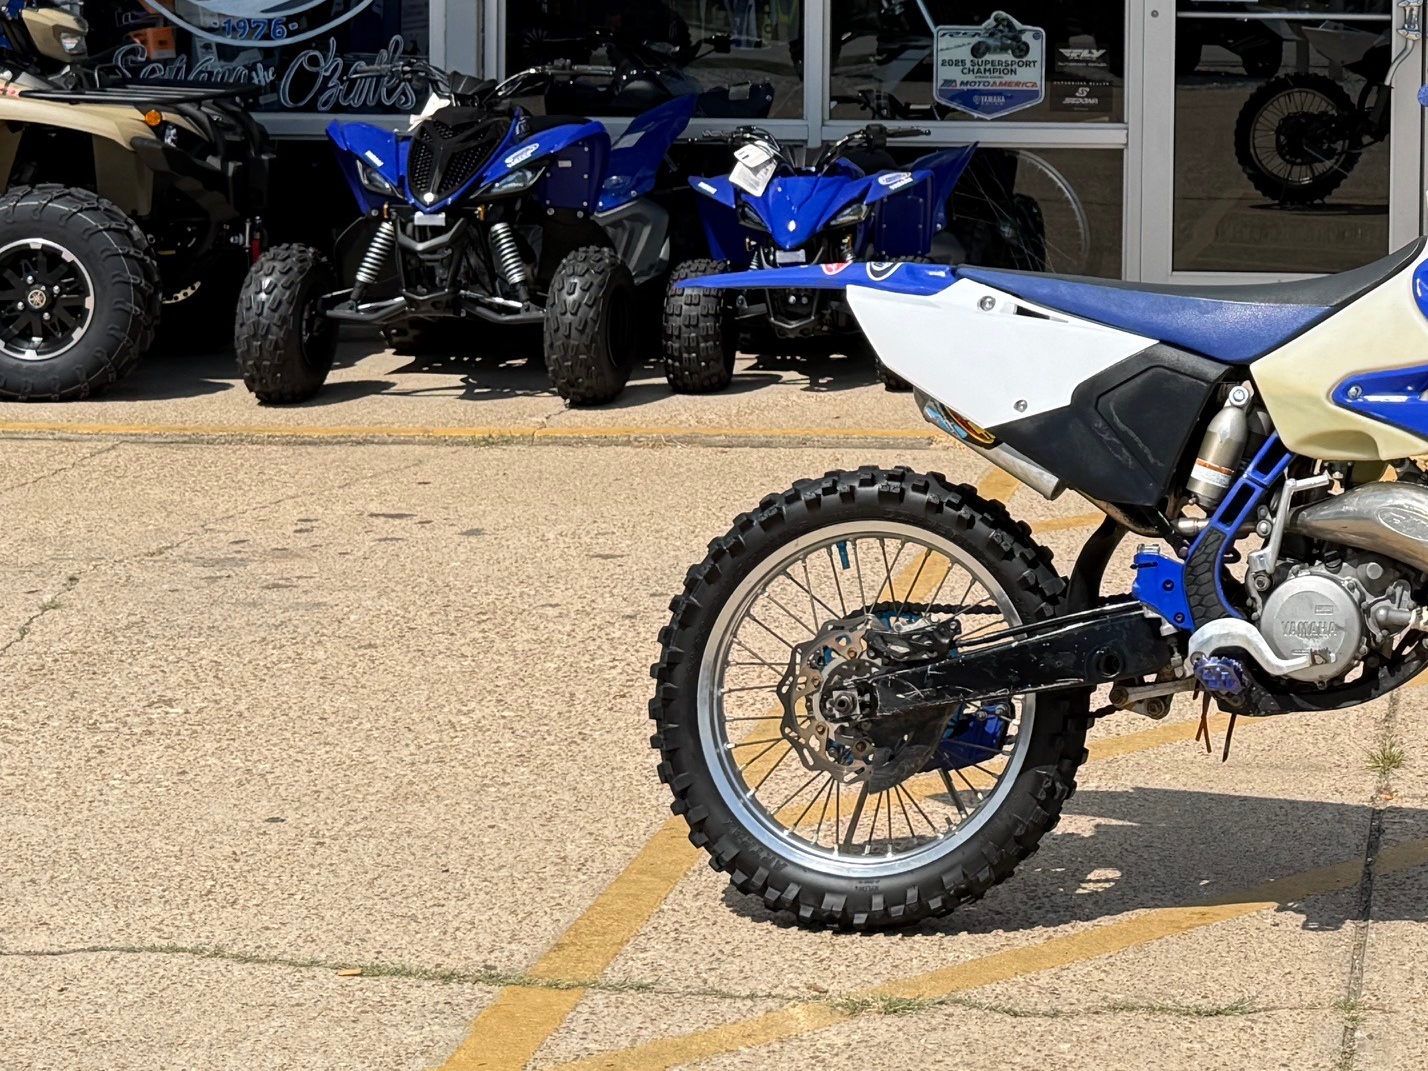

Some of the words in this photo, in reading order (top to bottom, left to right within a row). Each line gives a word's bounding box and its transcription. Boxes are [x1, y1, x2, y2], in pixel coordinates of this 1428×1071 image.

[222, 17, 288, 41] 1976
[941, 58, 967, 67] 2025
[970, 59, 1038, 68] SUPERSPORT
[961, 67, 1018, 76] CHAMPION
[959, 80, 1039, 88] MOTOAMERICA
[1281, 621, 1338, 637] YAMAHA
